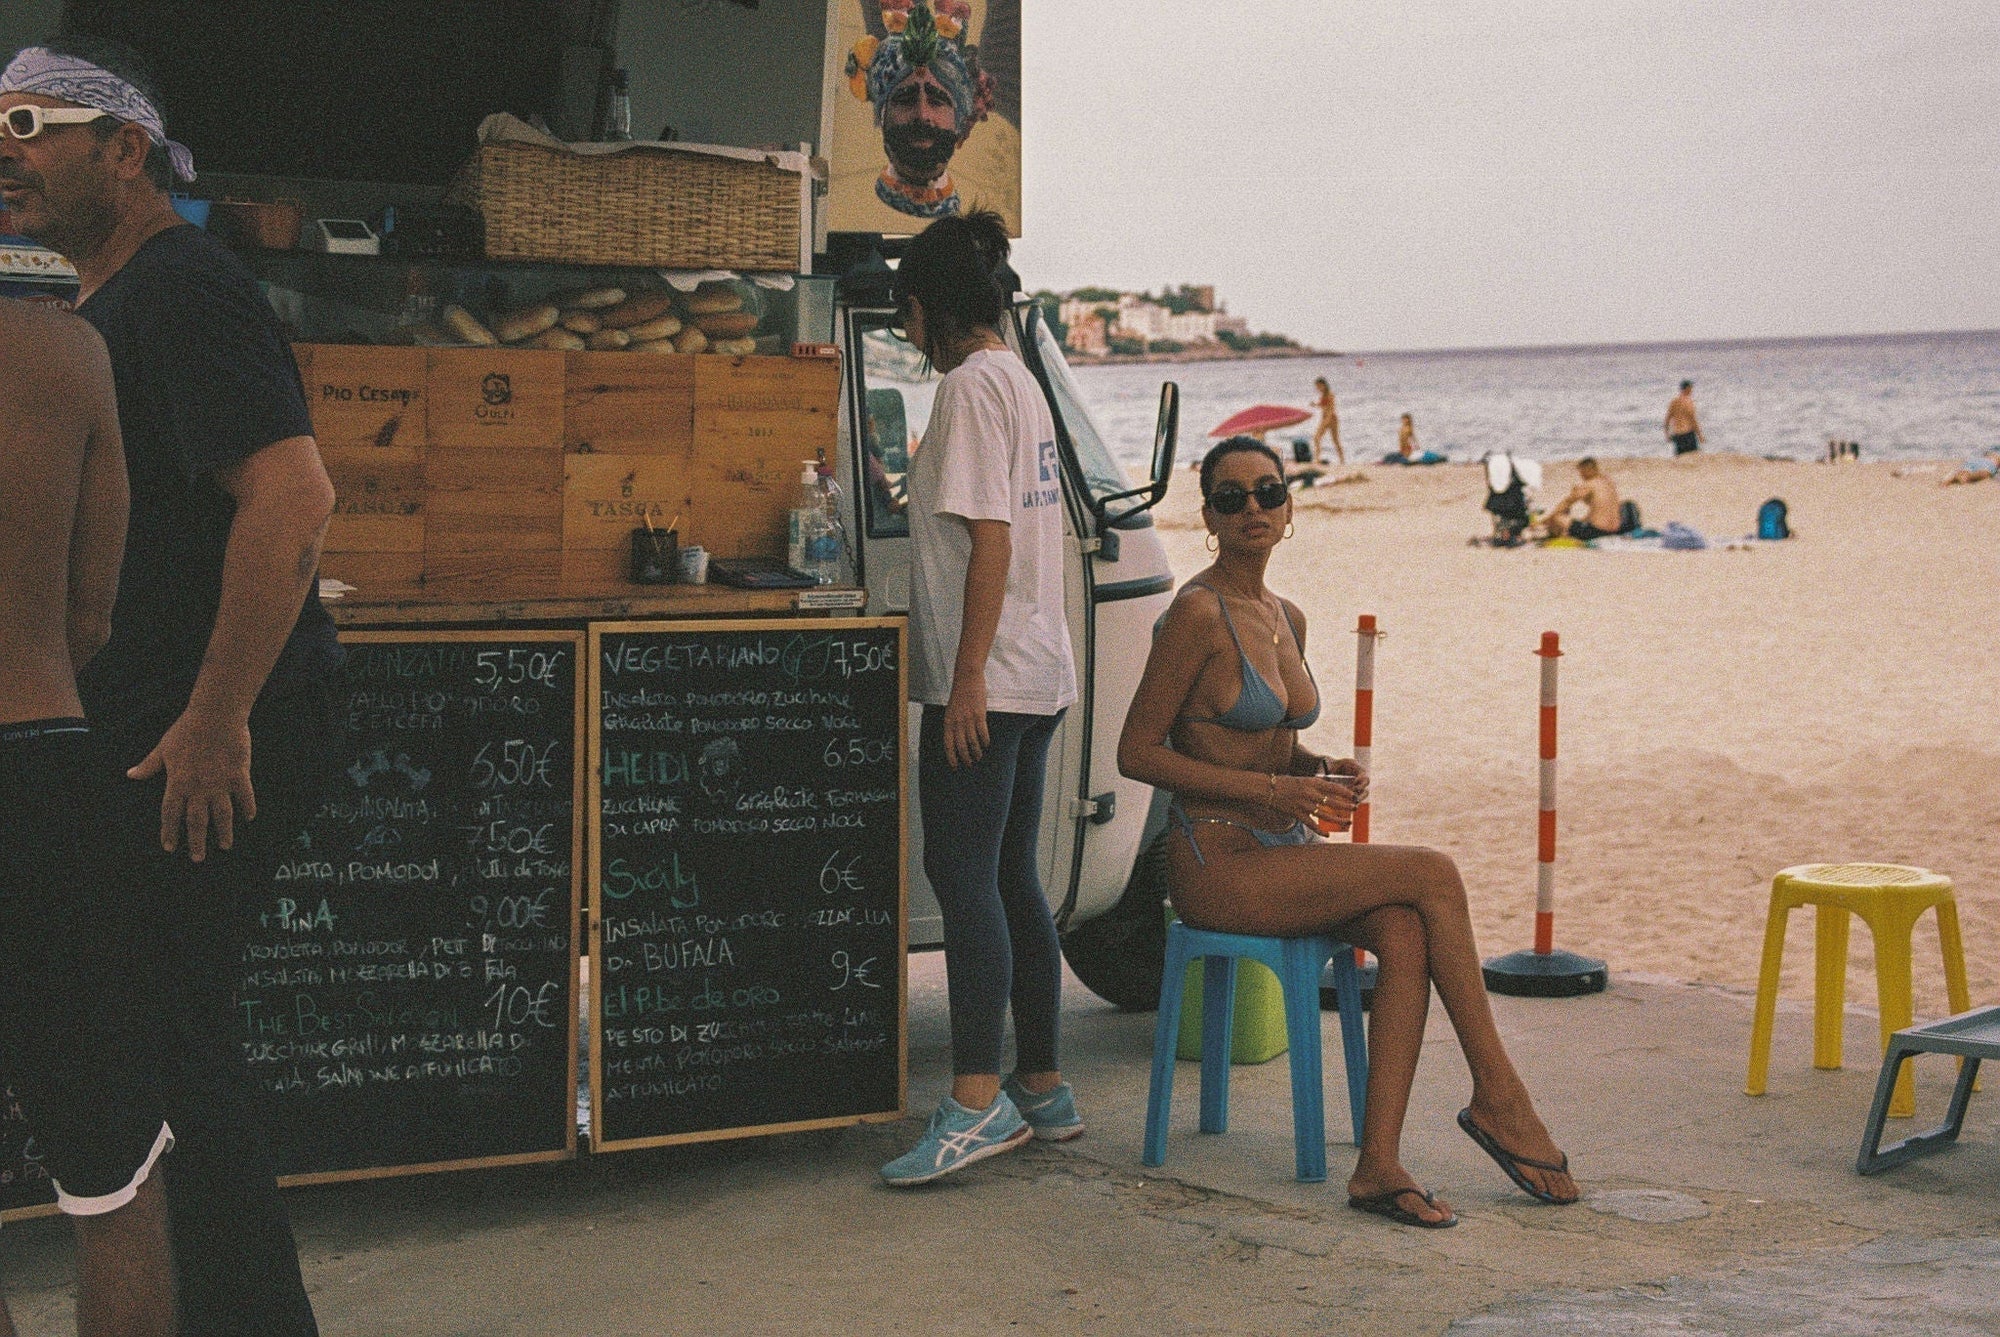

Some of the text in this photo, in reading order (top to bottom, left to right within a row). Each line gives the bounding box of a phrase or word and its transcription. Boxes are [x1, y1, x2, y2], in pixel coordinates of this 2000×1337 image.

[472, 647, 567, 693] 5,50€
[602, 747, 690, 787] HEIDI
[818, 849, 865, 894] 6€
[642, 937, 736, 973] BUFALA
[829, 949, 882, 992] 9€
[483, 980, 561, 1030] 10€
